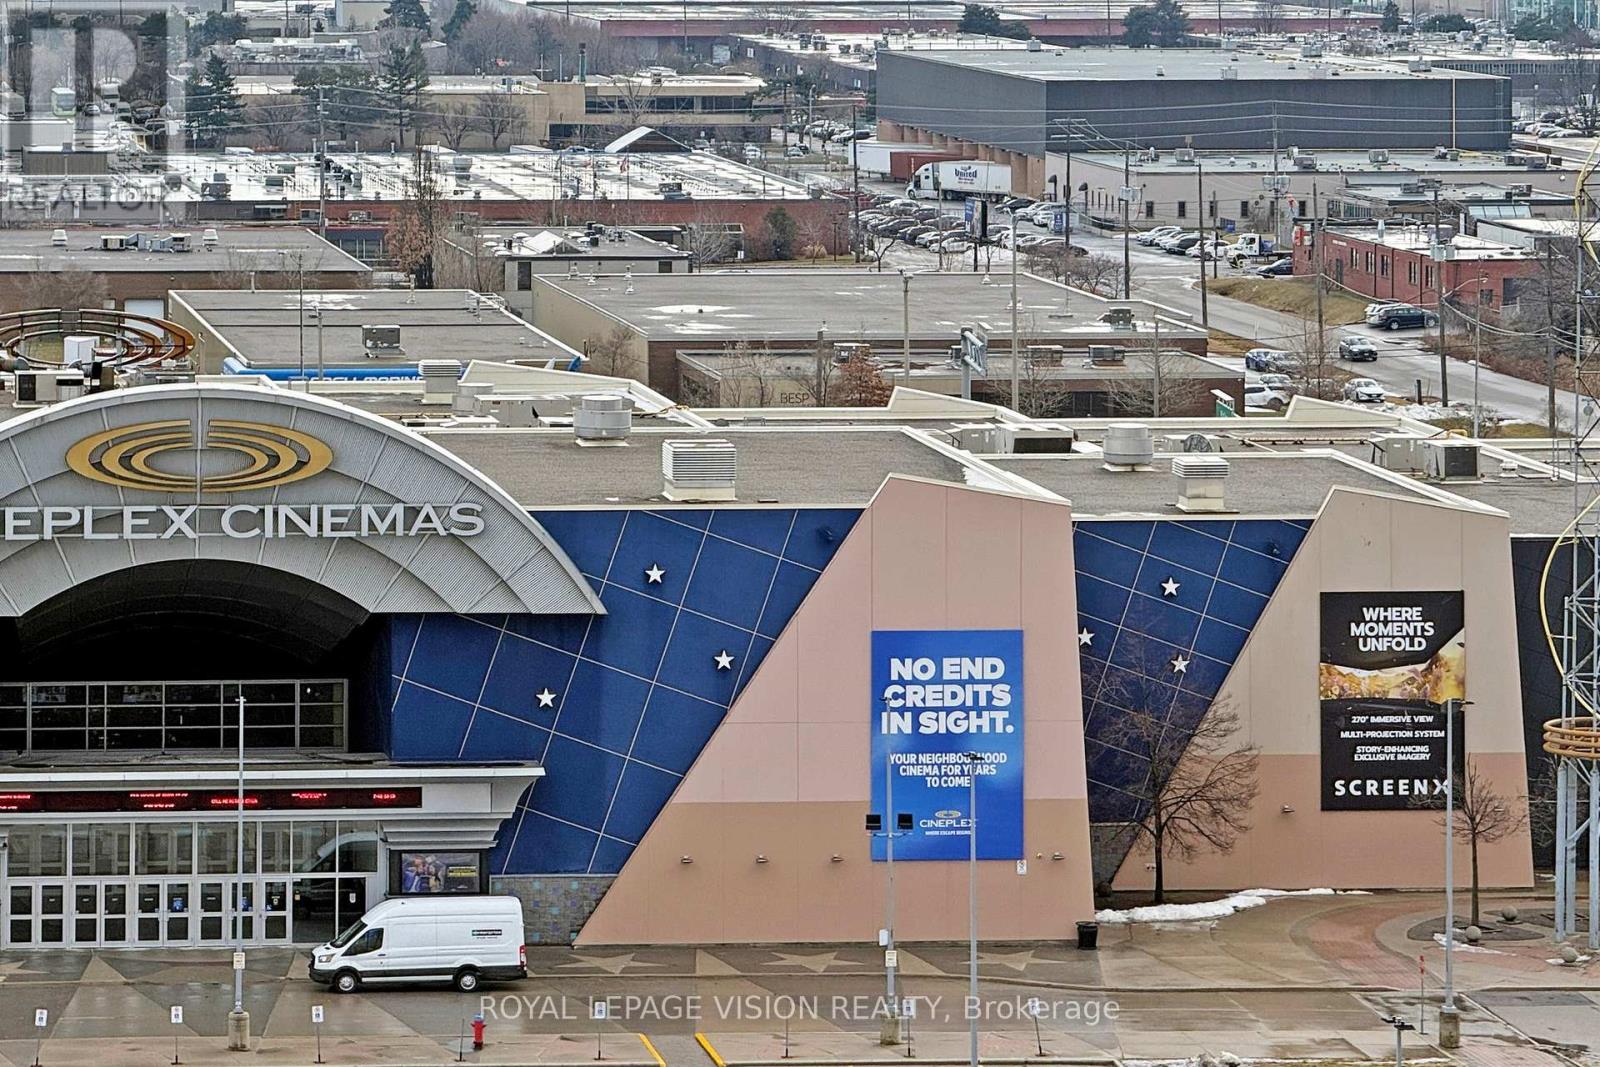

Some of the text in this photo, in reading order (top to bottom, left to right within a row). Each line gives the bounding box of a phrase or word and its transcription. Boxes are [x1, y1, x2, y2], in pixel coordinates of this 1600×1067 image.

[4, 502, 486, 541] EPLEX CINEMAS
[1362, 607, 1423, 621] WHERE
[1350, 622, 1435, 637] MOMENTS
[1358, 637, 1427, 652] UNFOLD
[890, 657, 1005, 681] NO END
[884, 683, 1011, 708] CREDITS
[881, 710, 1015, 735] IN SIGHT.
[1370, 715, 1411, 723] IMMERSIVE
[1413, 715, 1434, 723] VIEW
[1340, 730, 1445, 739] MULTI-PROJECTION SYSTEM
[1356, 745, 1429, 754] STORY-ENHANCING
[889, 753, 917, 764] YOUR
[1354, 753, 1431, 761] EXCLUSIVE IMAGERY
[899, 765, 939, 776] CINEMA
[941, 765, 961, 776] FOR
[925, 776, 971, 788] TO COME
[1334, 779, 1448, 796] SCREENX
